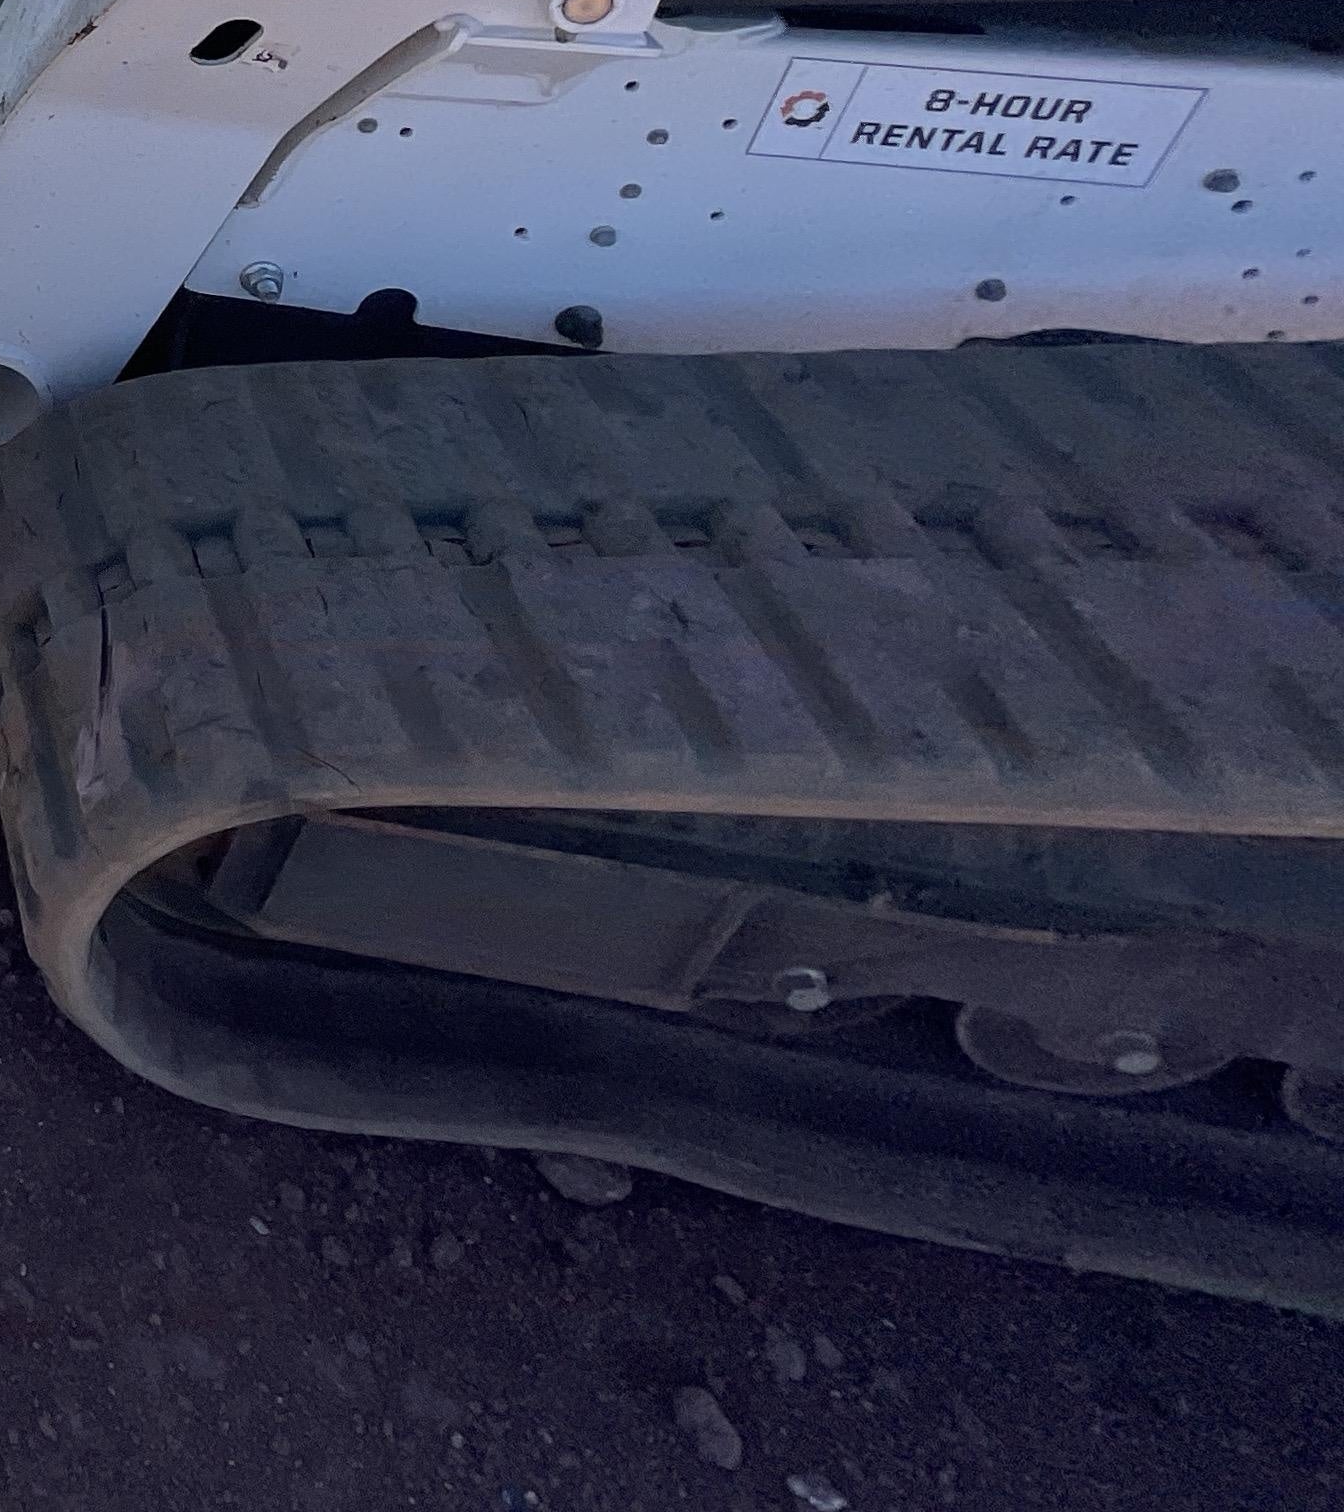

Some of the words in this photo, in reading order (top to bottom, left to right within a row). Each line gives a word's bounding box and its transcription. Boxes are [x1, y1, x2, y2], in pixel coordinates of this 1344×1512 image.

[924, 88, 1093, 124] 8-HOUR
[850, 121, 1008, 157] RENTAL
[1023, 135, 1140, 167] RATE
